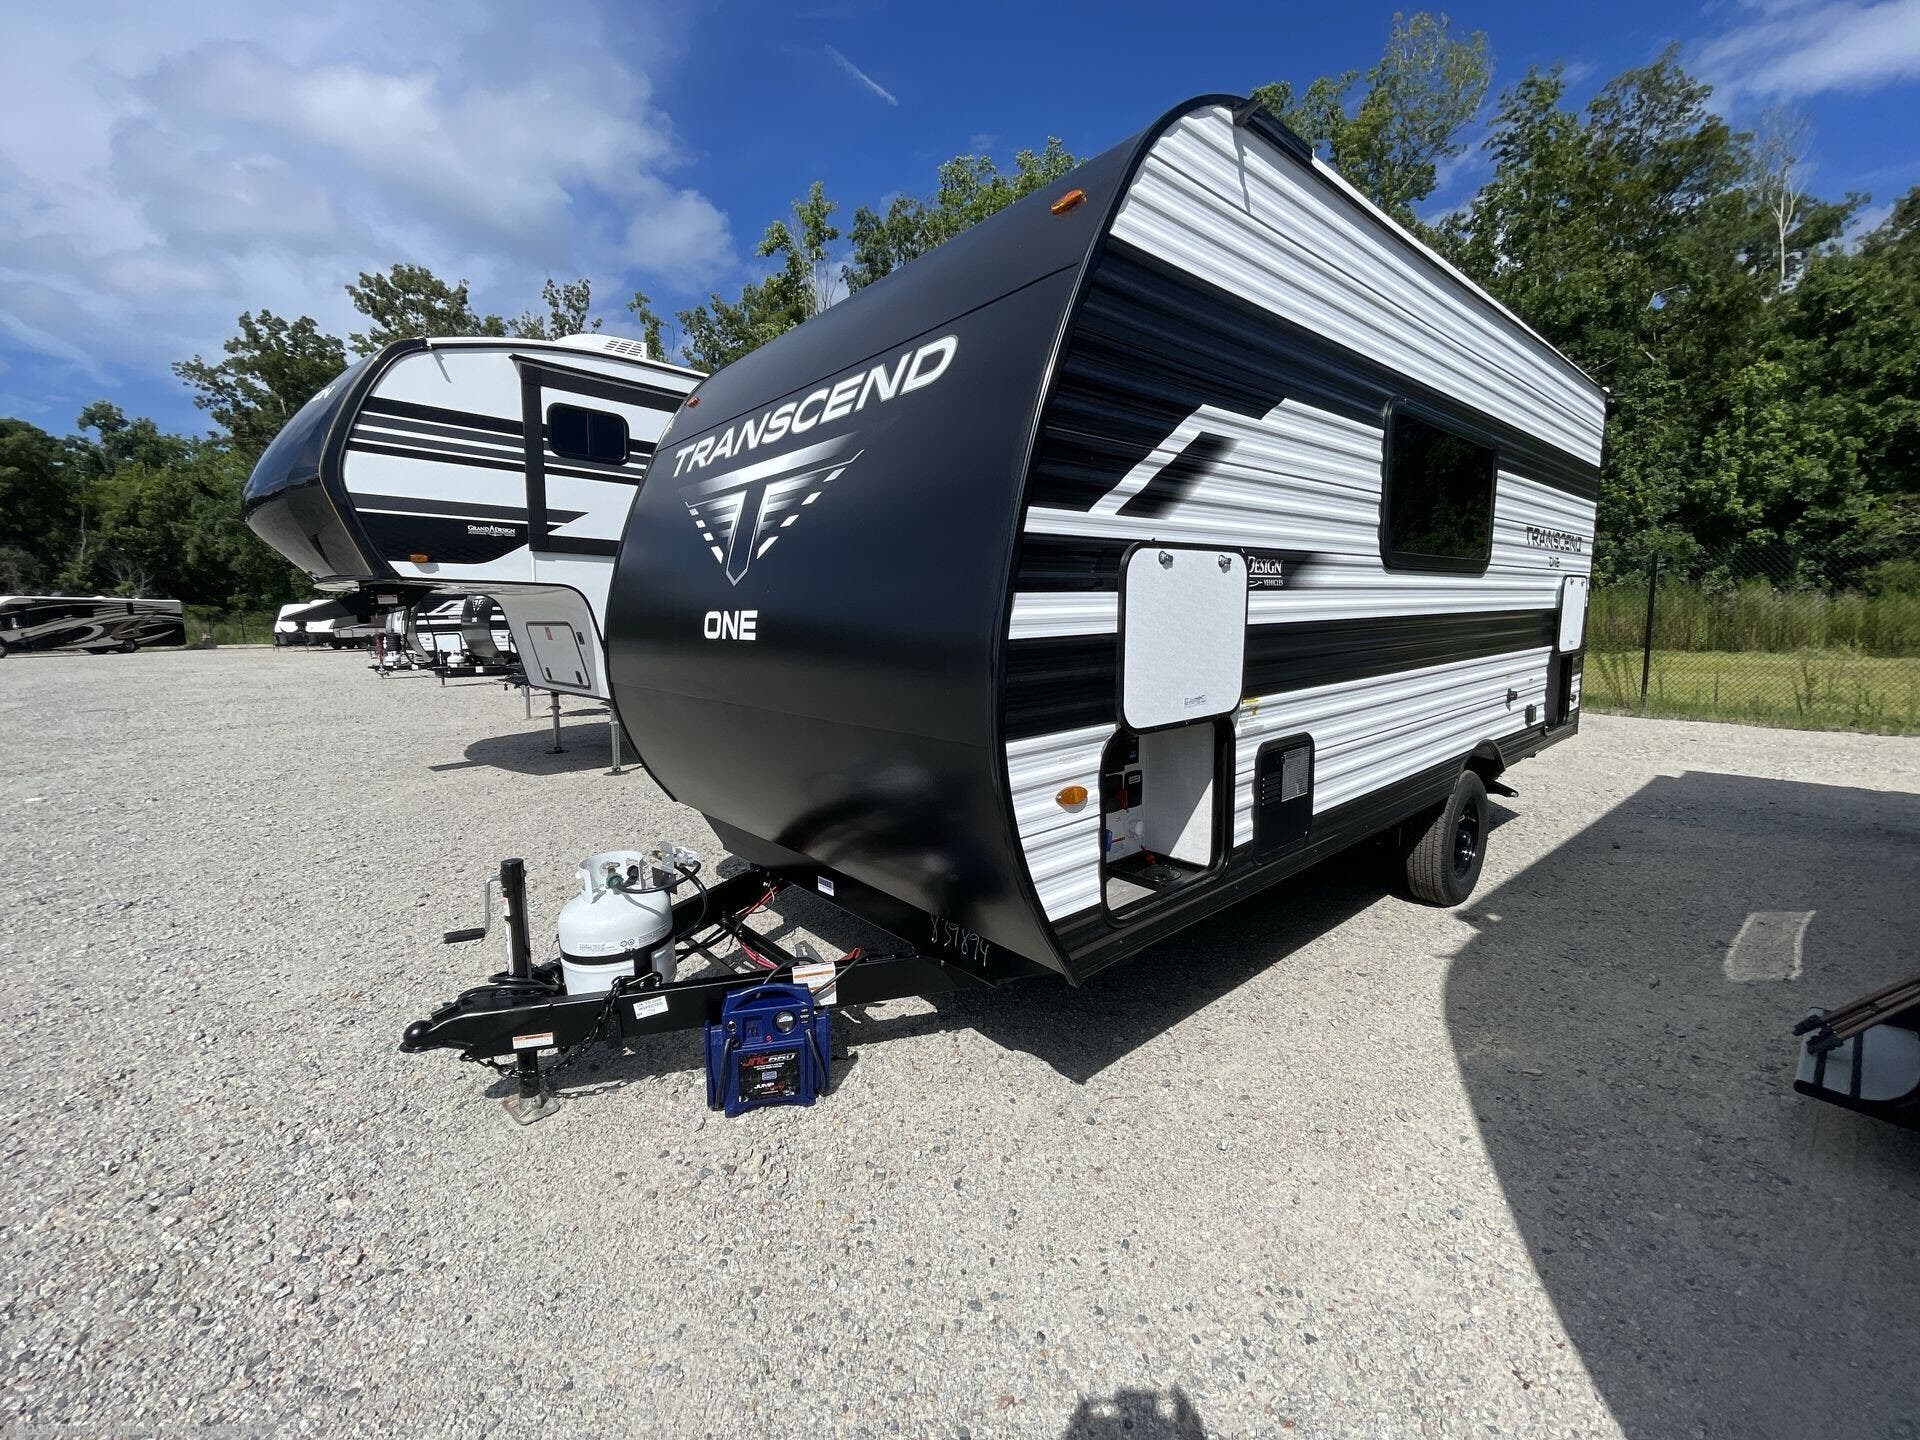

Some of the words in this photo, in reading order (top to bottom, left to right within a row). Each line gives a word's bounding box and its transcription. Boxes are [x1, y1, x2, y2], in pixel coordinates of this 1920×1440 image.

[671, 335, 958, 478] TRANSCEND
[1526, 526, 1582, 552] TRANSCEND
[1263, 579, 1284, 587] VEHICLES
[704, 610, 758, 640] ONE
